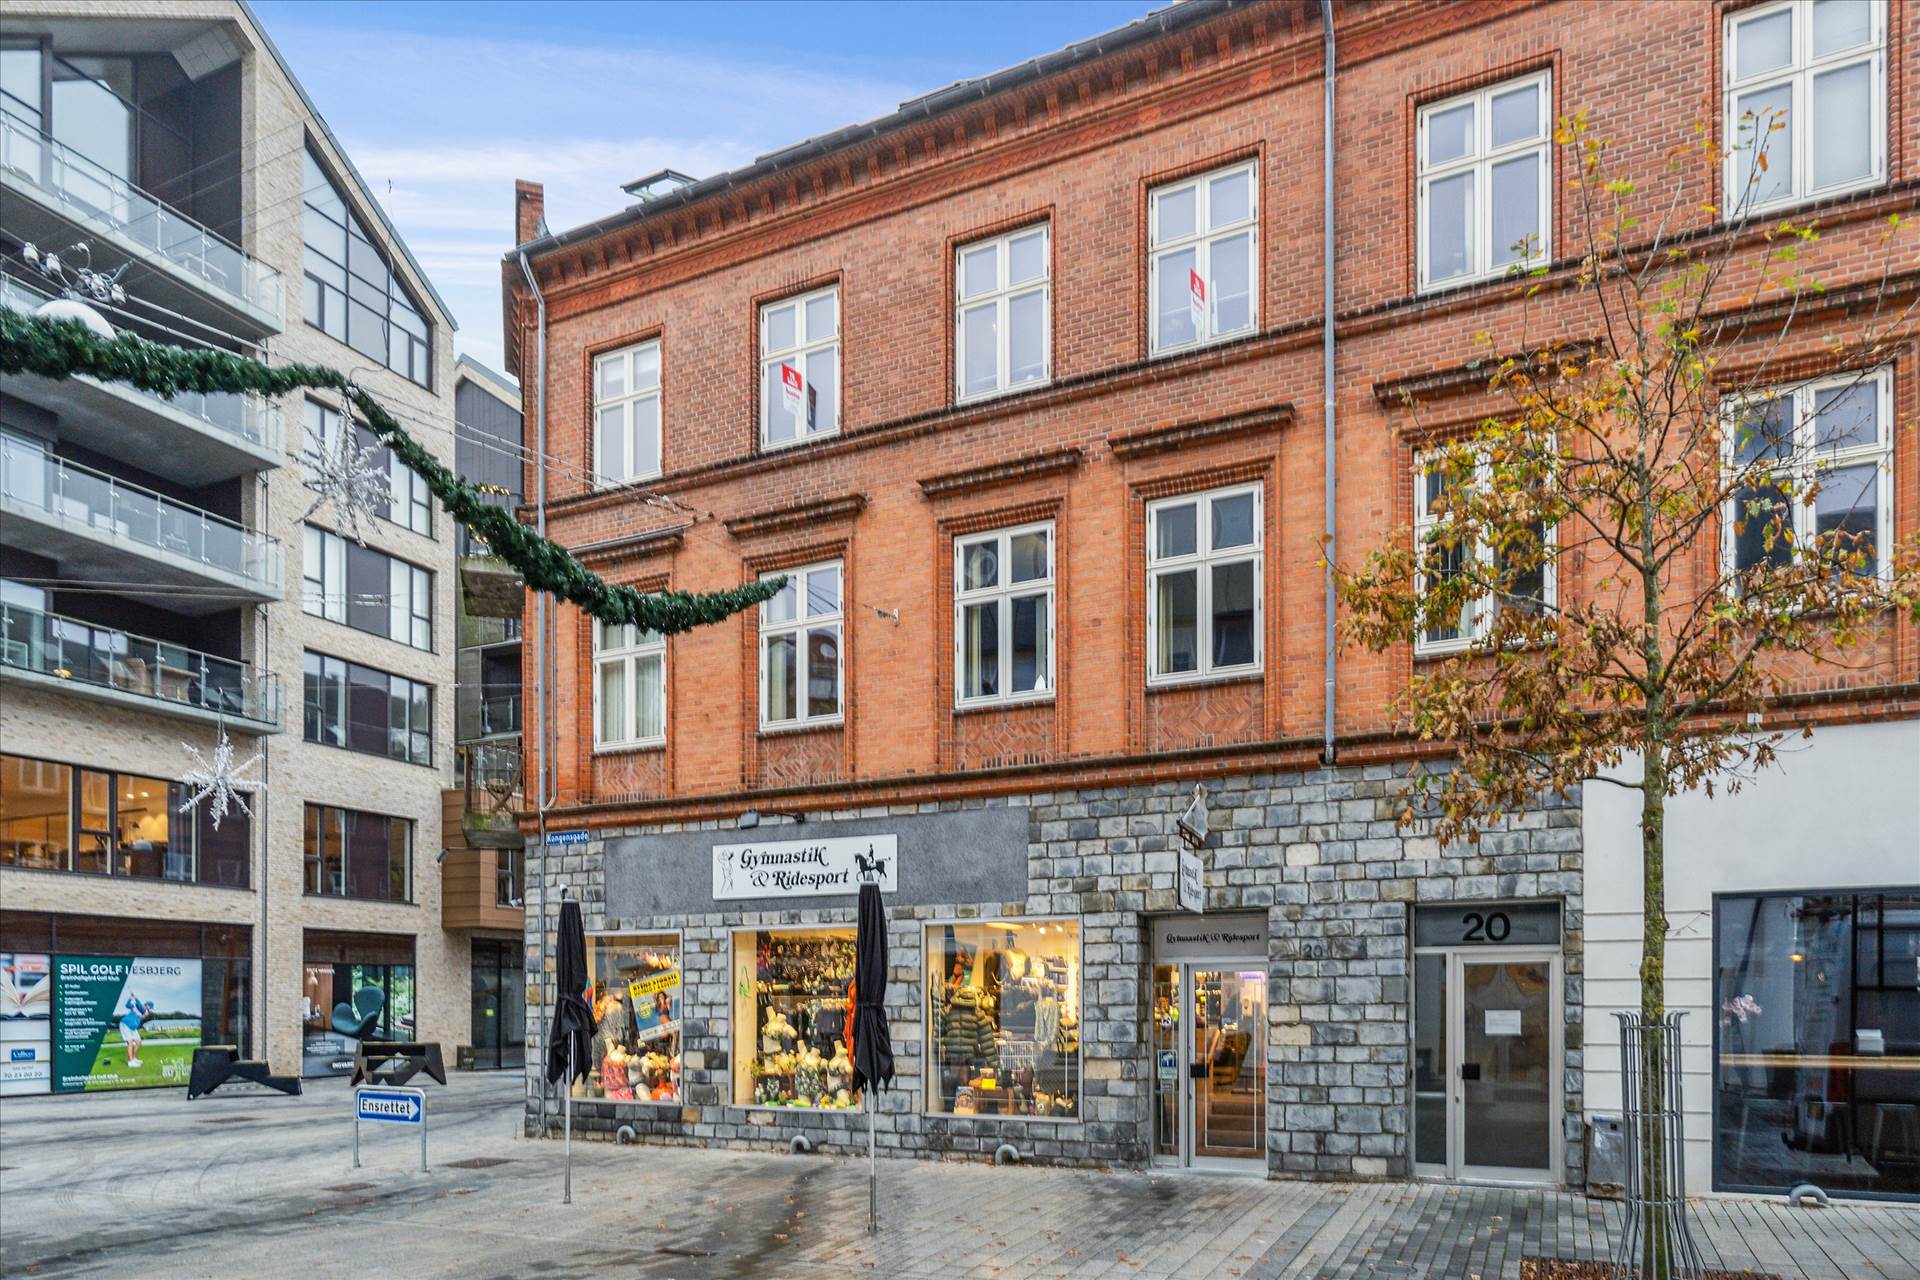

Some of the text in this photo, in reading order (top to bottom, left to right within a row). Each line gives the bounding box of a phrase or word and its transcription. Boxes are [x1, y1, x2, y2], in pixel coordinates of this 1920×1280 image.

[546, 831, 589, 844] Kongensgade
[772, 868, 849, 890] Ridesport
[1462, 911, 1511, 941] 20
[60, 963, 88, 975] SPIL
[90, 964, 122, 975] GOLF
[132, 966, 181, 976] ESBJERG
[362, 1098, 410, 1114] Ensrettet
